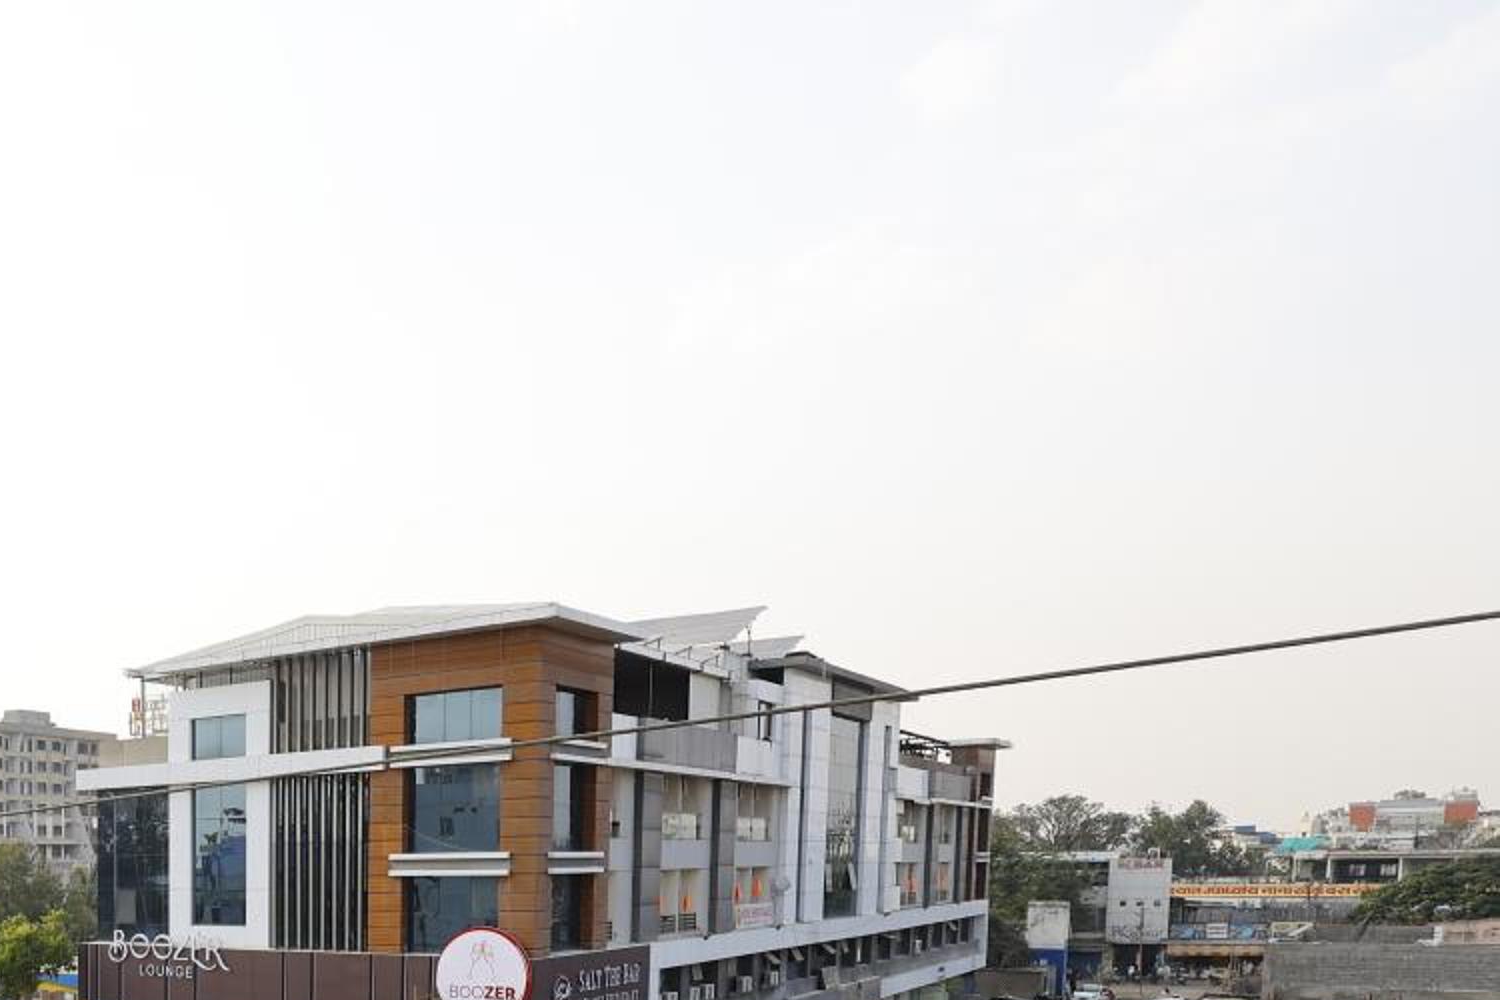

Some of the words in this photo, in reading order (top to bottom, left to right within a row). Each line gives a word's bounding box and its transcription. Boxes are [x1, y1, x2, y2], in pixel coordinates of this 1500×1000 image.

[107, 928, 231, 972] BOOZER
[139, 963, 194, 979] LOUNGE
[449, 984, 517, 1000] BOOZER
